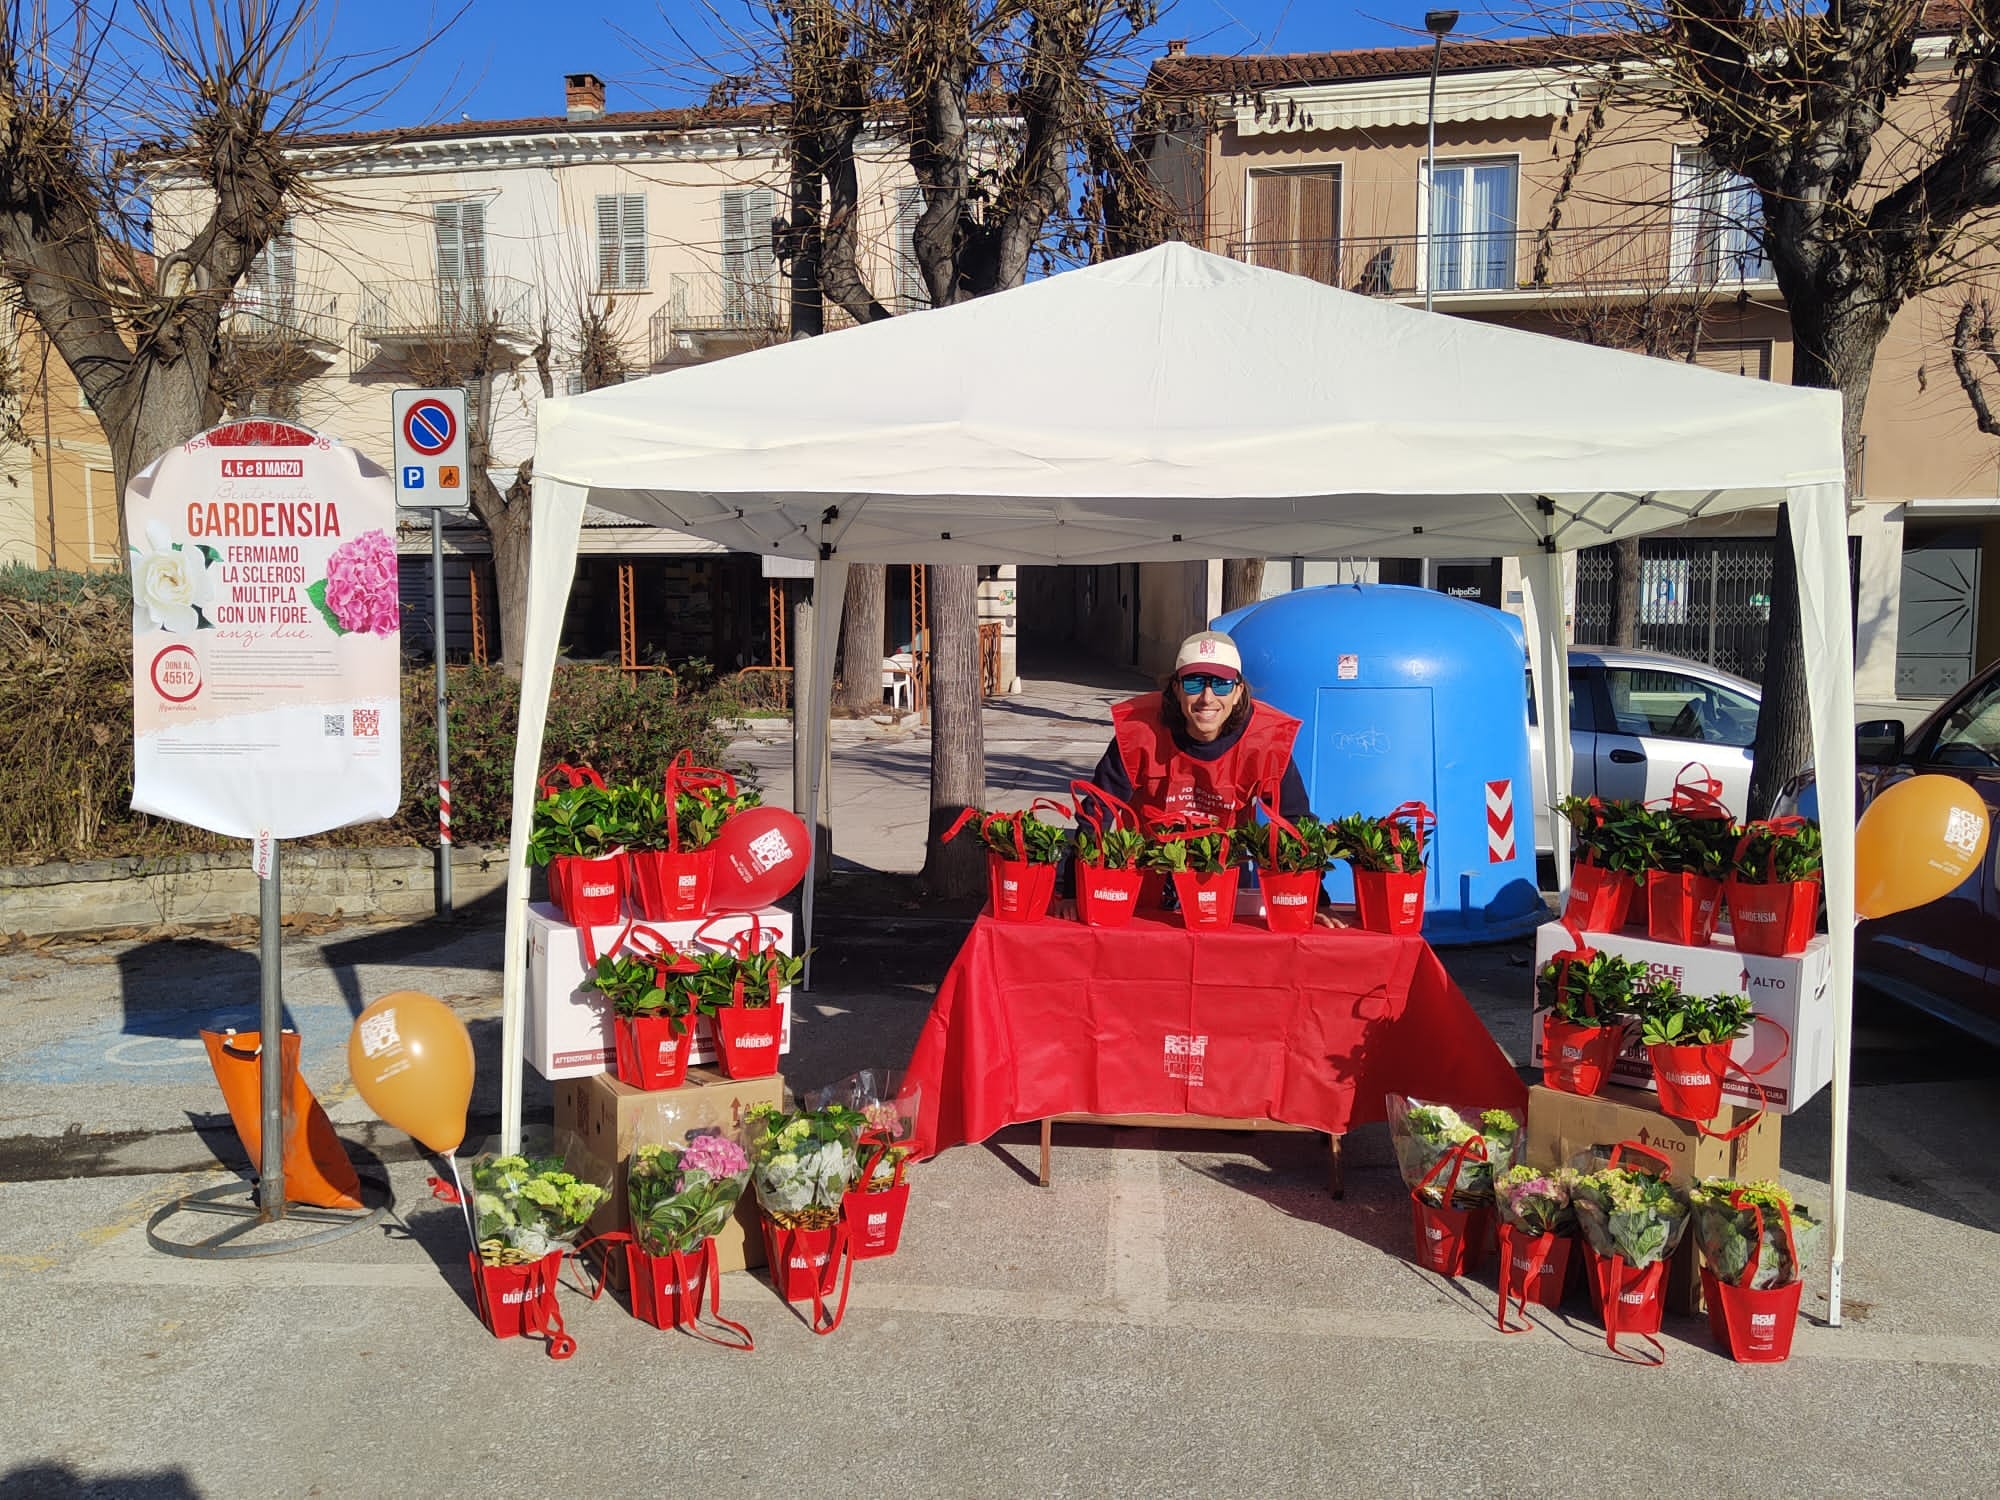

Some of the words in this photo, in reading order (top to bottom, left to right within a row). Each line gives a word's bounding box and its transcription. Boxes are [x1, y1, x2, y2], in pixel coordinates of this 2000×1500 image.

[224, 462, 234, 476] 4,
[245, 465, 254, 475] e
[255, 462, 263, 475] 8
[265, 462, 300, 475] MARZO
[409, 469, 420, 486] P
[187, 502, 341, 537] GARDENSIA
[228, 546, 299, 563] FERMIAMO
[222, 566, 239, 583] LA
[242, 566, 305, 583] SCLEROSI
[232, 586, 296, 603] MULTIPLA
[217, 606, 244, 623] CON
[249, 606, 266, 623] UN
[270, 606, 312, 623] FIORE.
[165, 661, 182, 670] DONA
[163, 672, 194, 684] 45512
[1753, 977, 1785, 990] ALTO
[1653, 1137, 1686, 1153] ALTO
